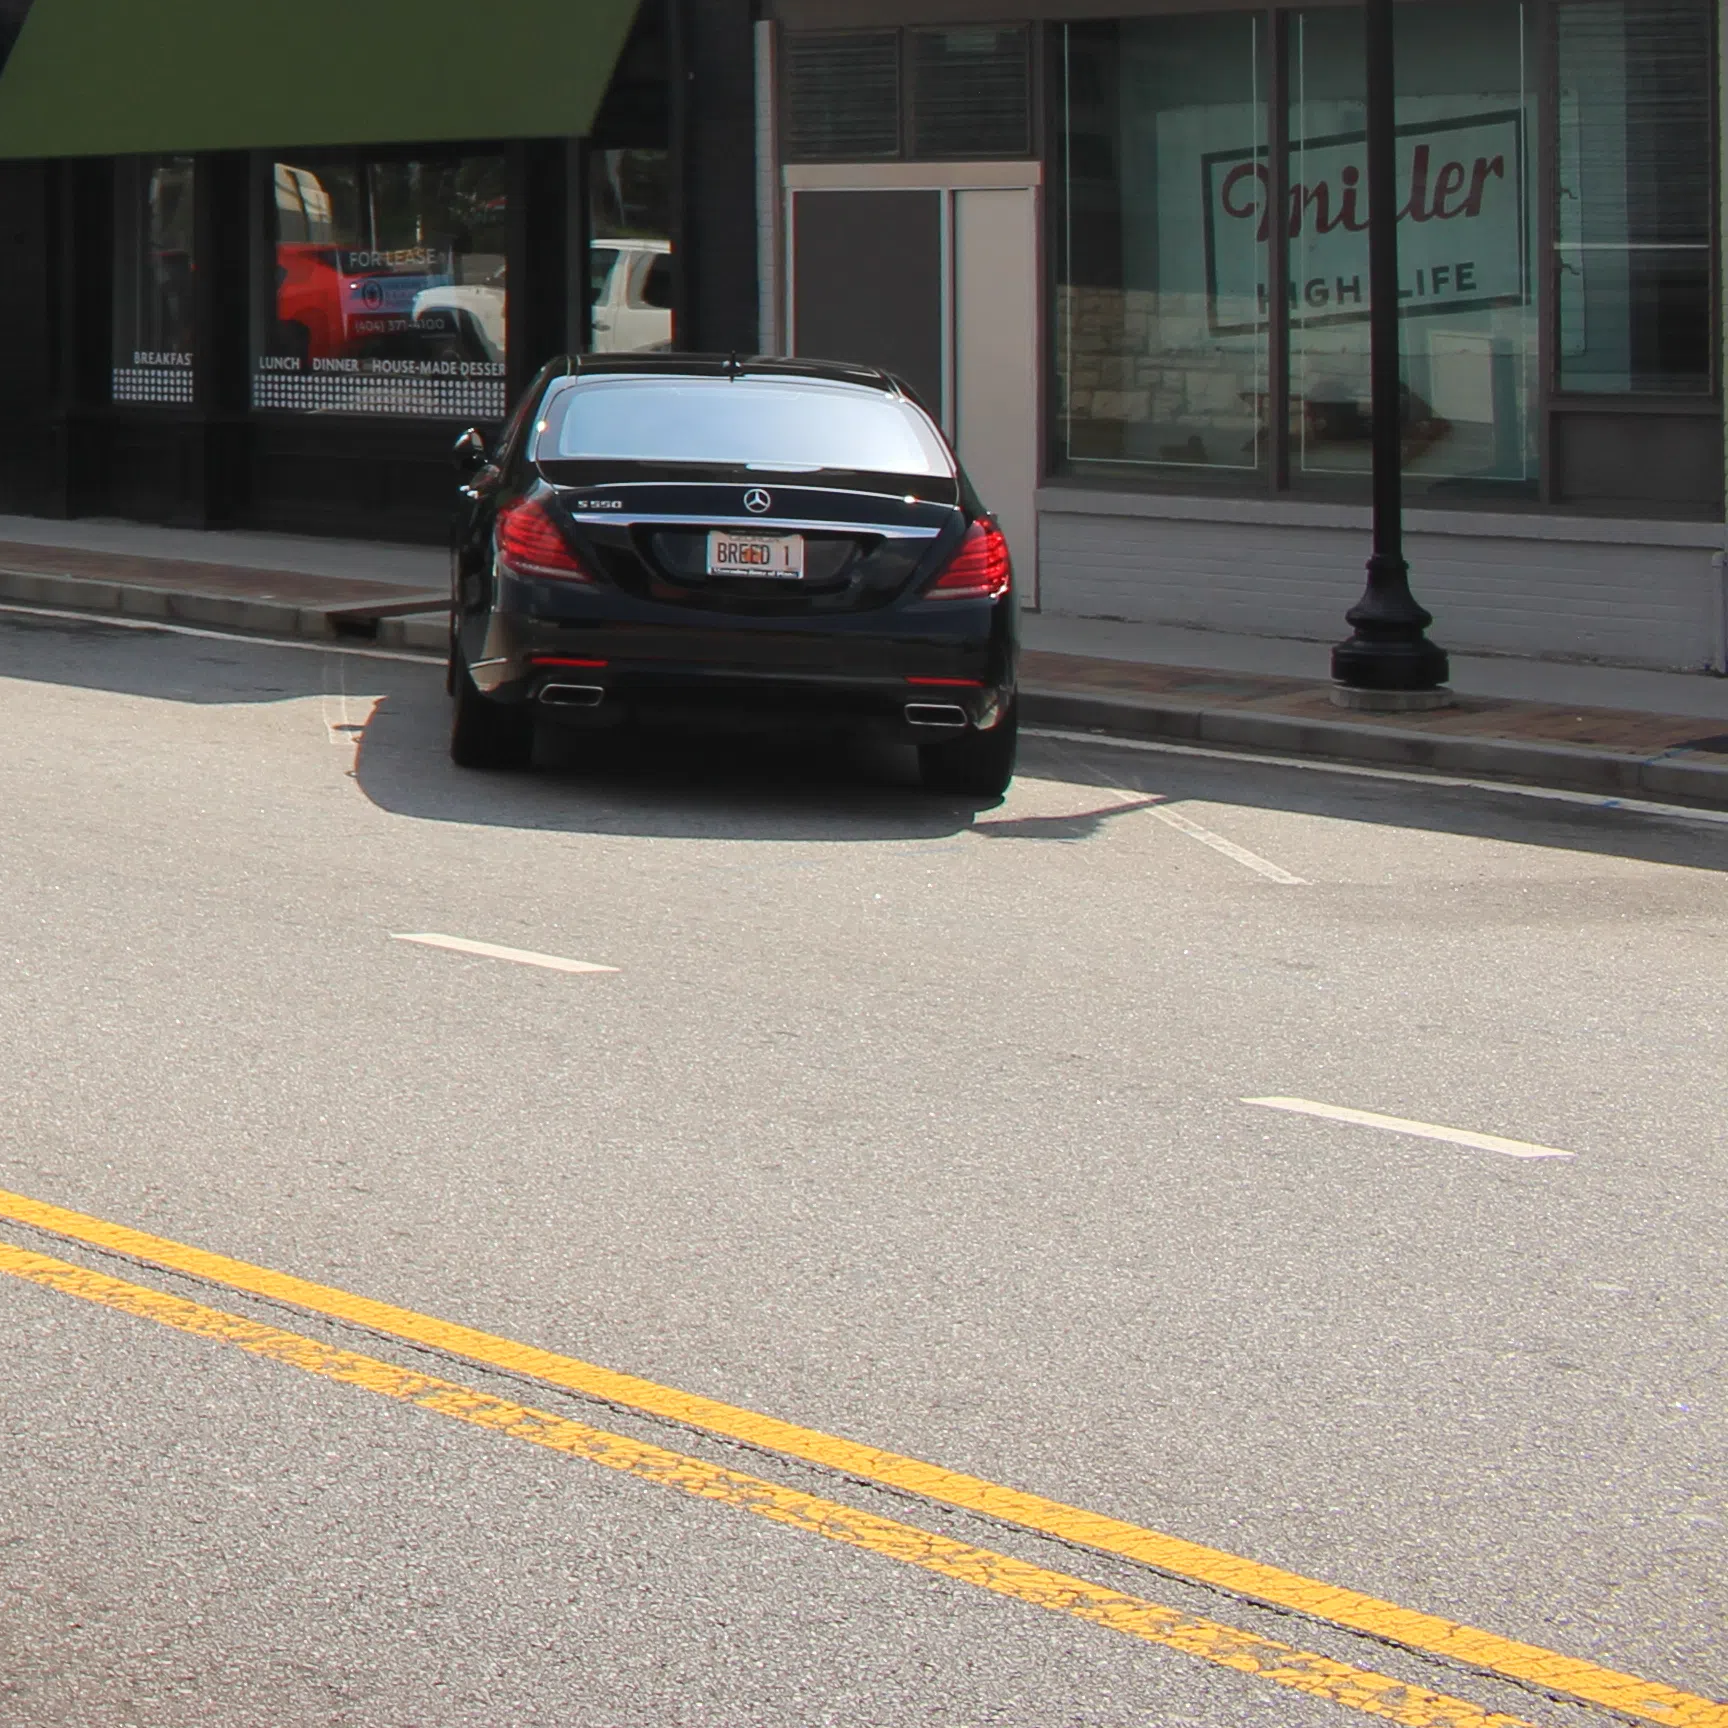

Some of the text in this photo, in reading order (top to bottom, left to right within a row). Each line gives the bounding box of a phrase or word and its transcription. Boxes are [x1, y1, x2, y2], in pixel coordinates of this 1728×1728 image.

[1221, 144, 1505, 243] Miler
[350, 248, 436, 267] FOR LEASE
[134, 351, 193, 366] BREAKFAS
[259, 356, 301, 370] LUNCH
[312, 358, 360, 372] DINNER
[371, 358, 457, 375] HOUSE-MADE
[577, 500, 588, 509] S
[717, 542, 789, 566] BREED 1
